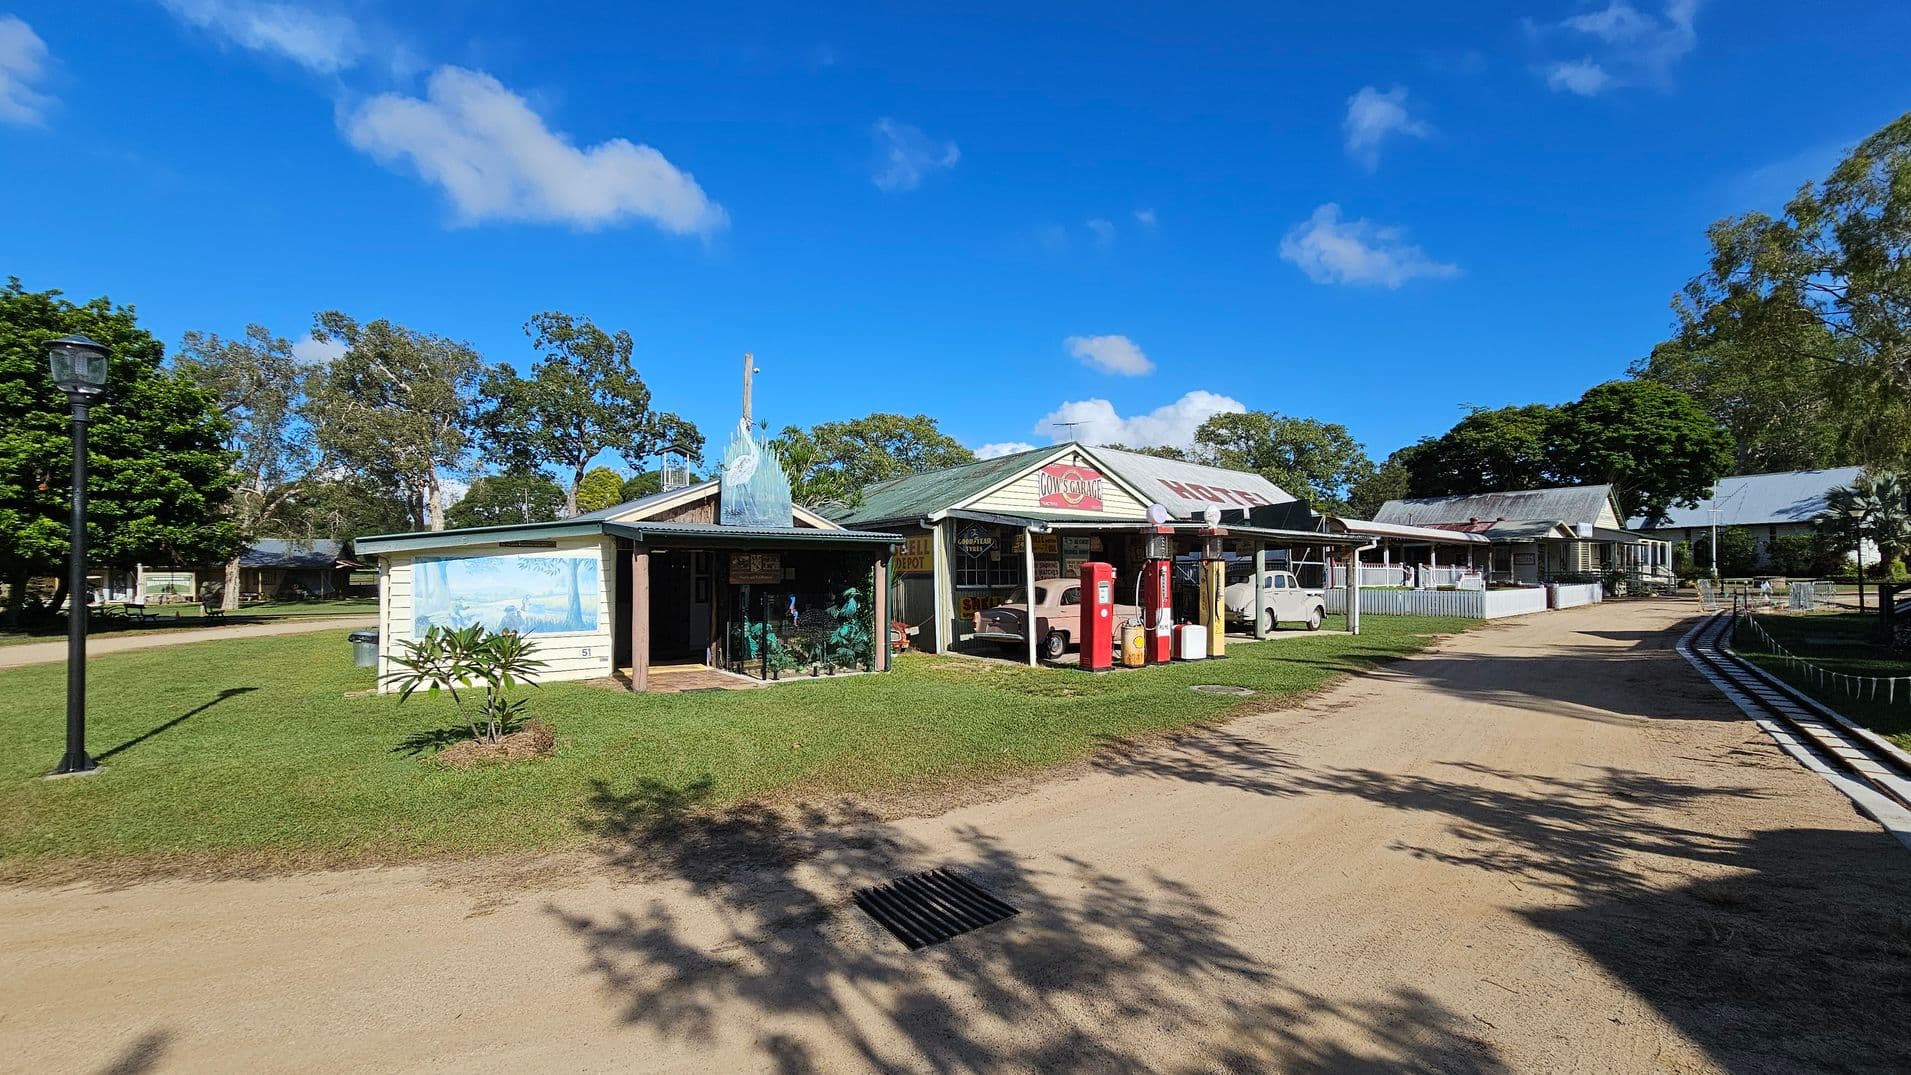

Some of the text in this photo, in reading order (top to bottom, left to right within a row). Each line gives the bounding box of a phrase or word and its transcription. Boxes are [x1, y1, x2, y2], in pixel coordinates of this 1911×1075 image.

[1040, 472, 1102, 500] GOW'S GARAGE
[957, 536, 992, 546] GOODYEAR
[896, 556, 925, 569] DEPOT
[582, 648, 592, 657] 51
